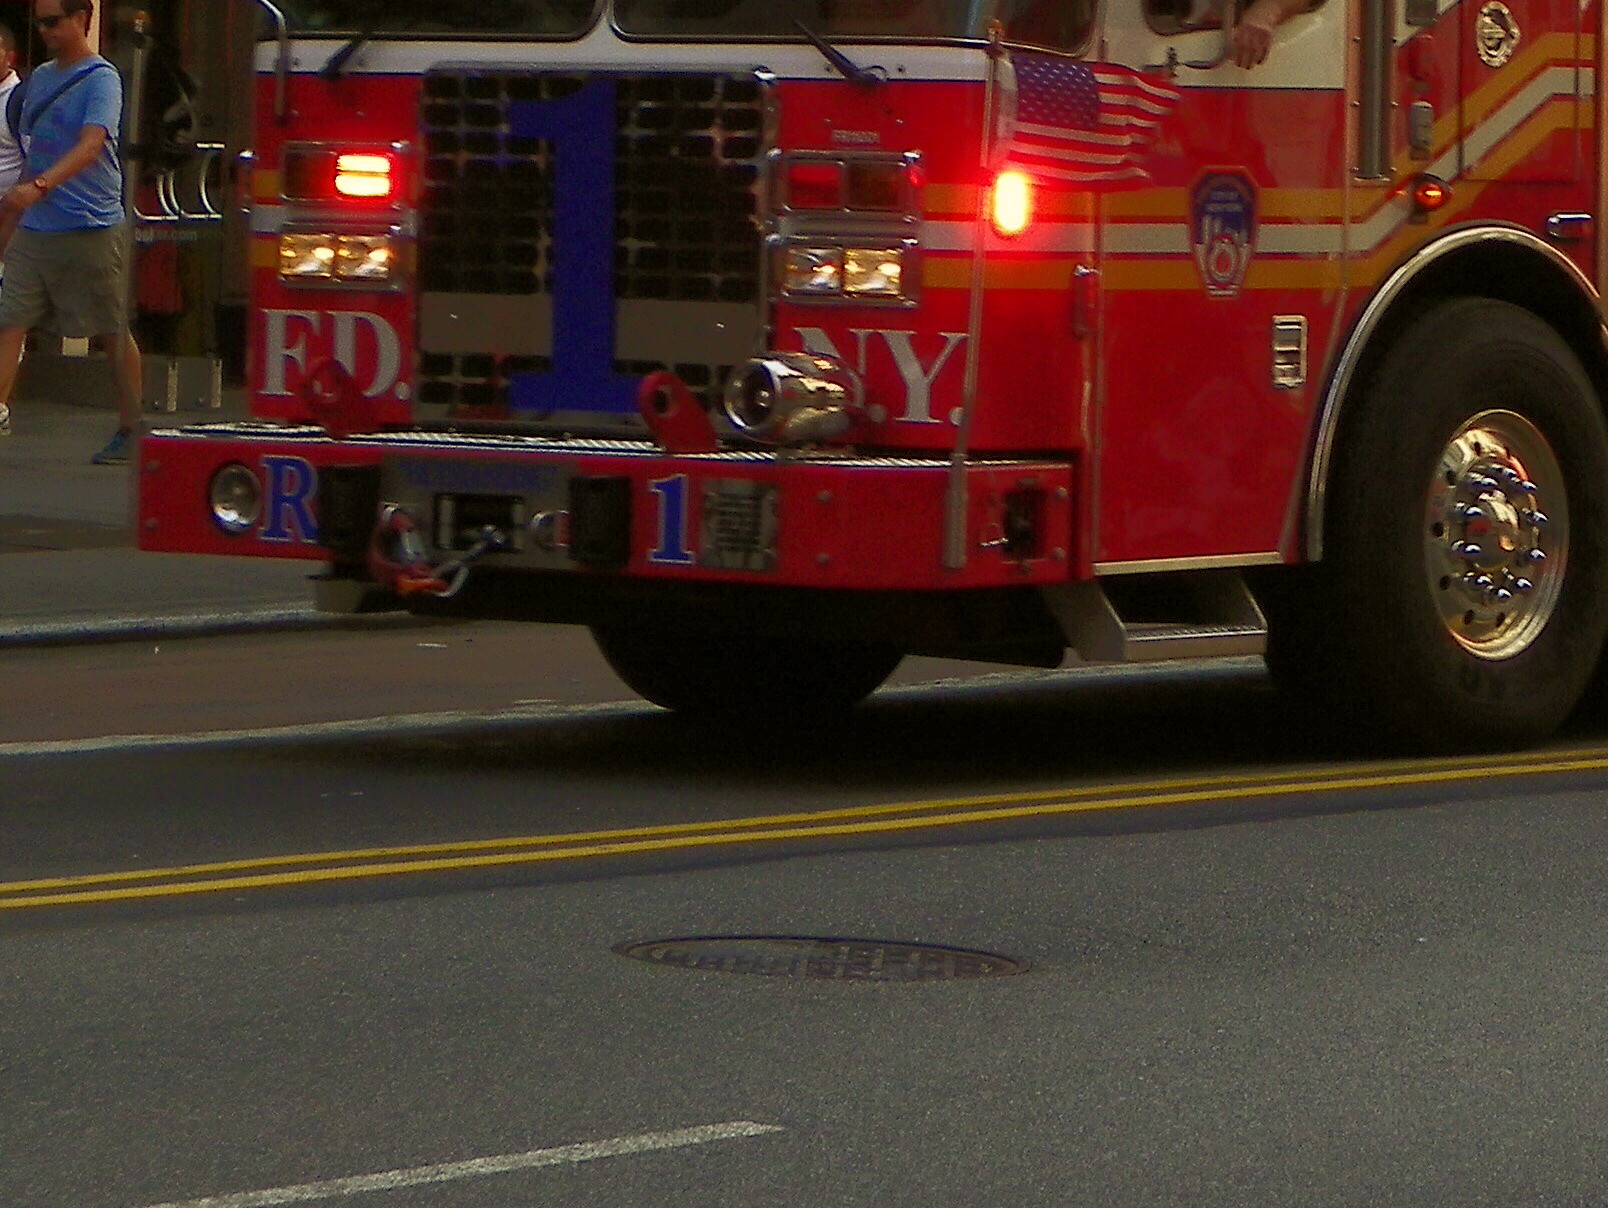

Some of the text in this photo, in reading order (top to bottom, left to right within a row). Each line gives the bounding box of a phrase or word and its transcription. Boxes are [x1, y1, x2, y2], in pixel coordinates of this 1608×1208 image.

[506, 76, 645, 414] 1
[259, 454, 319, 543] R
[648, 473, 695, 565] 1
